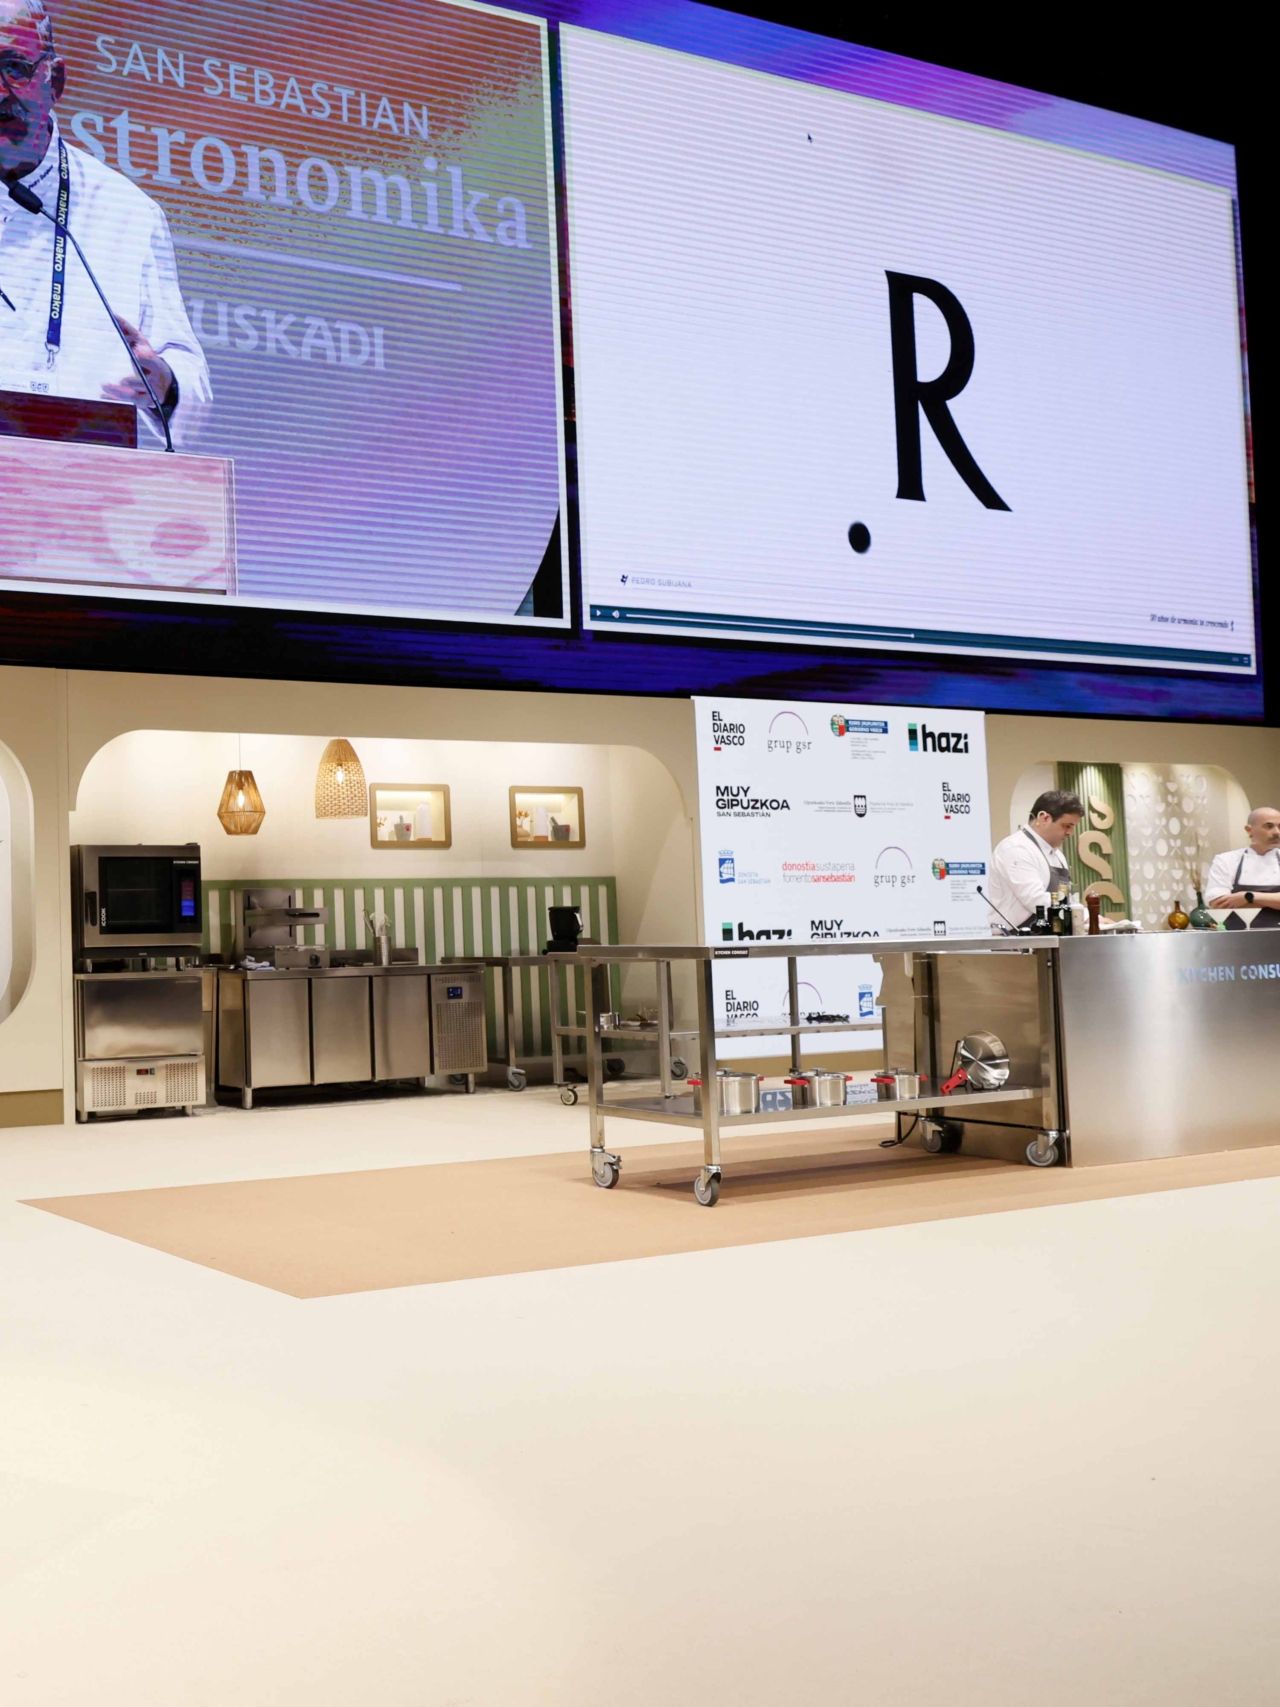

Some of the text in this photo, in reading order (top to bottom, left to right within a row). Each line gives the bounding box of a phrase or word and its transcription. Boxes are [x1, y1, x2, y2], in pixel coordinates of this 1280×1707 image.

[95, 34, 430, 139] SAN SEBASTIAN
[70, 108, 533, 248] stronomika
[57, 190, 68, 225] makro
[54, 235, 64, 272] makro
[51, 282, 62, 319] makro
[189, 298, 386, 370] USKADI
[712, 711, 723, 721] EL
[712, 722, 746, 734] DIARIO
[713, 735, 746, 746] VASCO
[921, 723, 969, 754] hazi
[767, 739, 812, 754] grup gsr
[715, 785, 751, 797] MUY
[942, 782, 952, 792] EL
[715, 798, 791, 810] GIPUZKOA
[942, 793, 971, 803] DIARIO
[944, 804, 971, 814] VASCO
[873, 874, 916, 887] grup gsr
[810, 919, 844, 931] MUY
[725, 989, 737, 1001] EL
[725, 1000, 759, 1012] DIARIO
